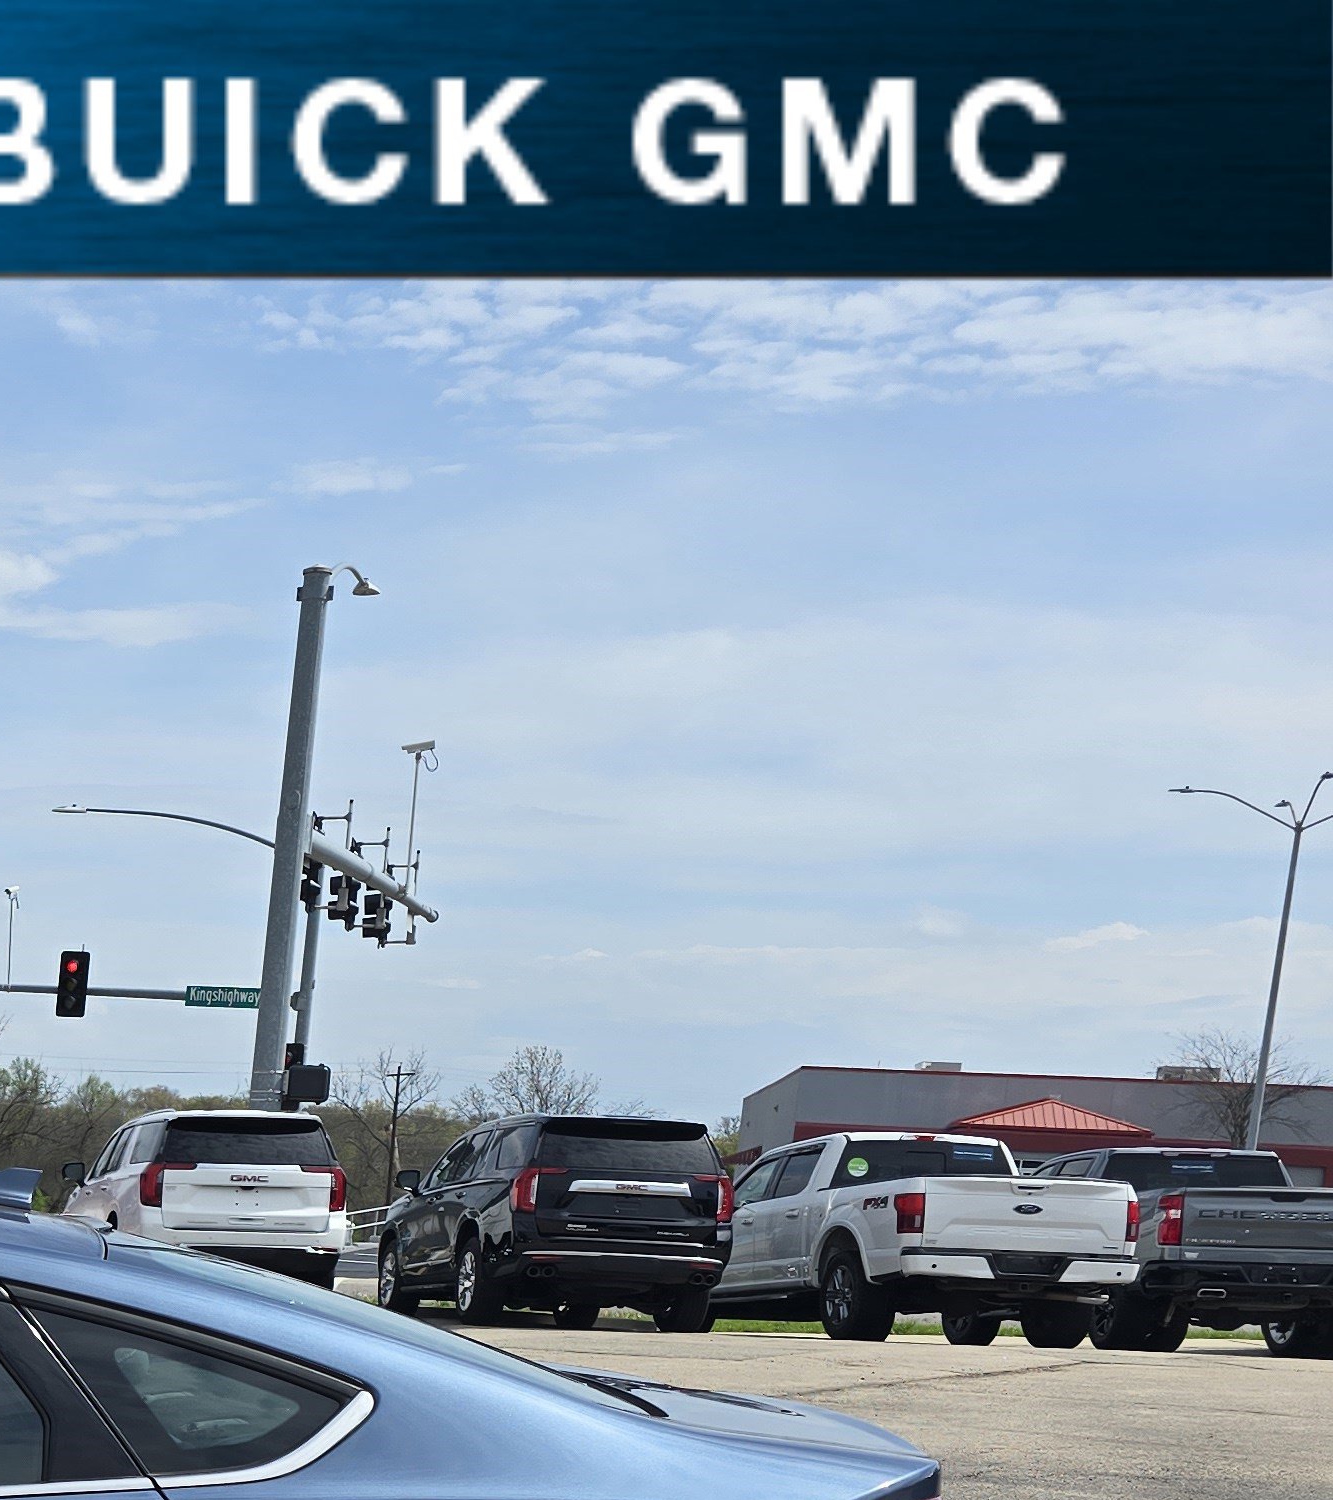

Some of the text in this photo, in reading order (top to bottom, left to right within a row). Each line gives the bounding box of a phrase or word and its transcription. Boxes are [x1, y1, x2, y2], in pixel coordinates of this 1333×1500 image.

[189, 986, 261, 1007] Kingshighway
[229, 1174, 270, 1183] GMC
[615, 1184, 649, 1192] GMC
